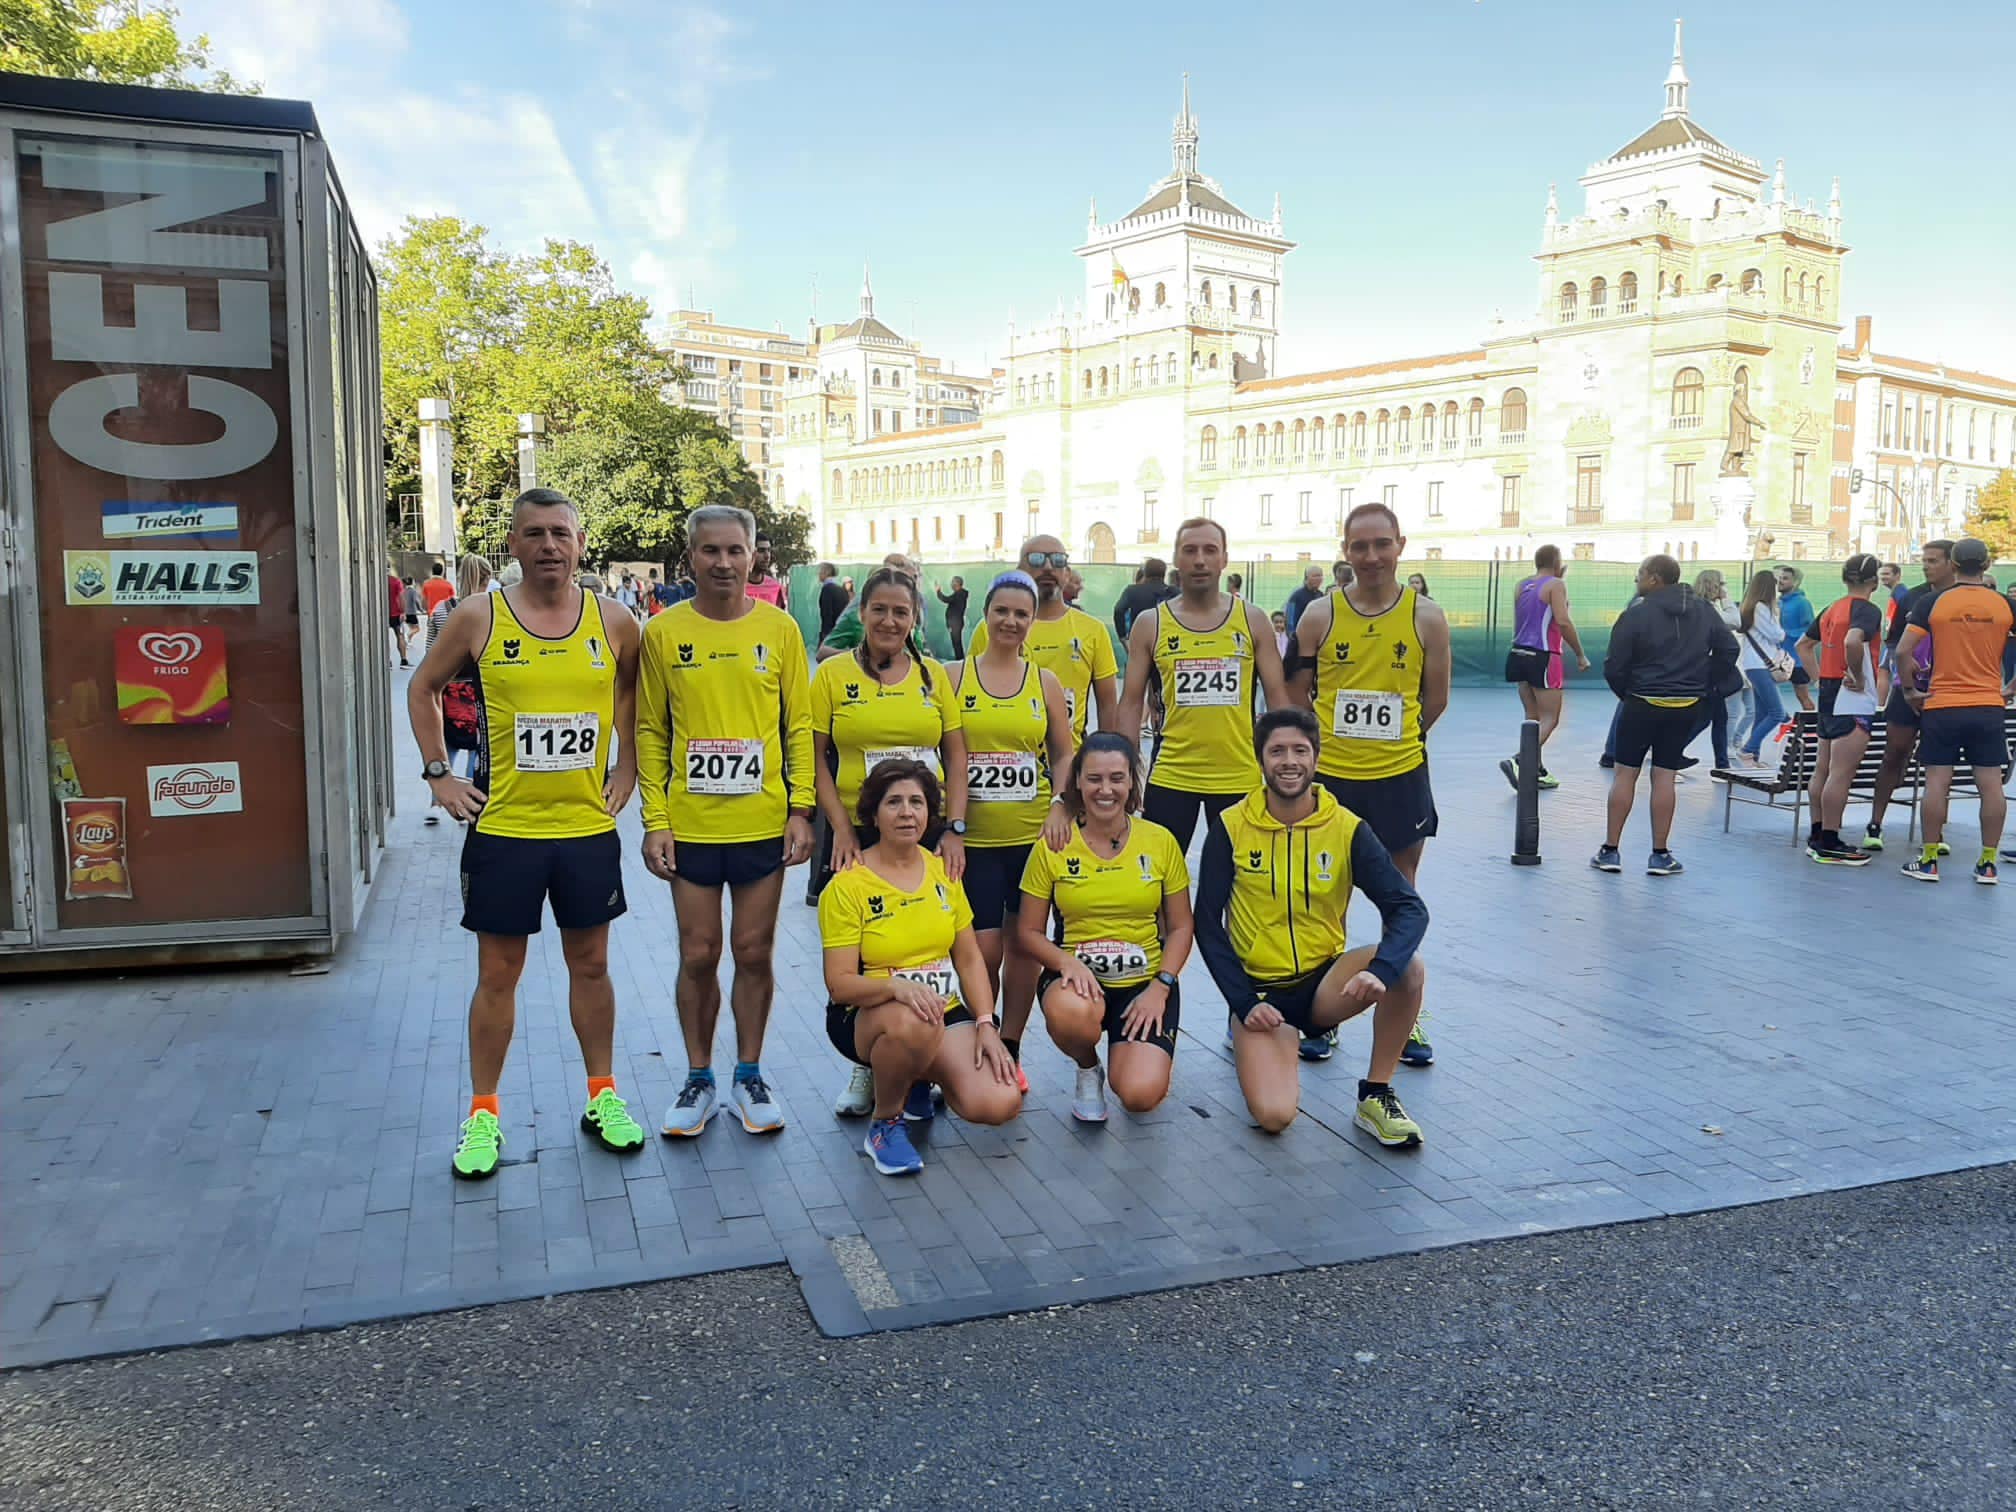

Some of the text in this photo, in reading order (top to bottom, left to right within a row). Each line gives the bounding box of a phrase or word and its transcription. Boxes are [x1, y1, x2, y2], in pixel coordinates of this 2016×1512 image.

[136, 514, 204, 530] Trident
[115, 562, 253, 593] HALLS
[153, 666, 190, 675] FRIGO
[1177, 671, 1238, 693] 2245
[1344, 703, 1391, 727] 816
[519, 728, 595, 755] 1128
[689, 754, 760, 779] 2074
[968, 766, 1034, 788] 2290
[155, 776, 236, 801] facundo
